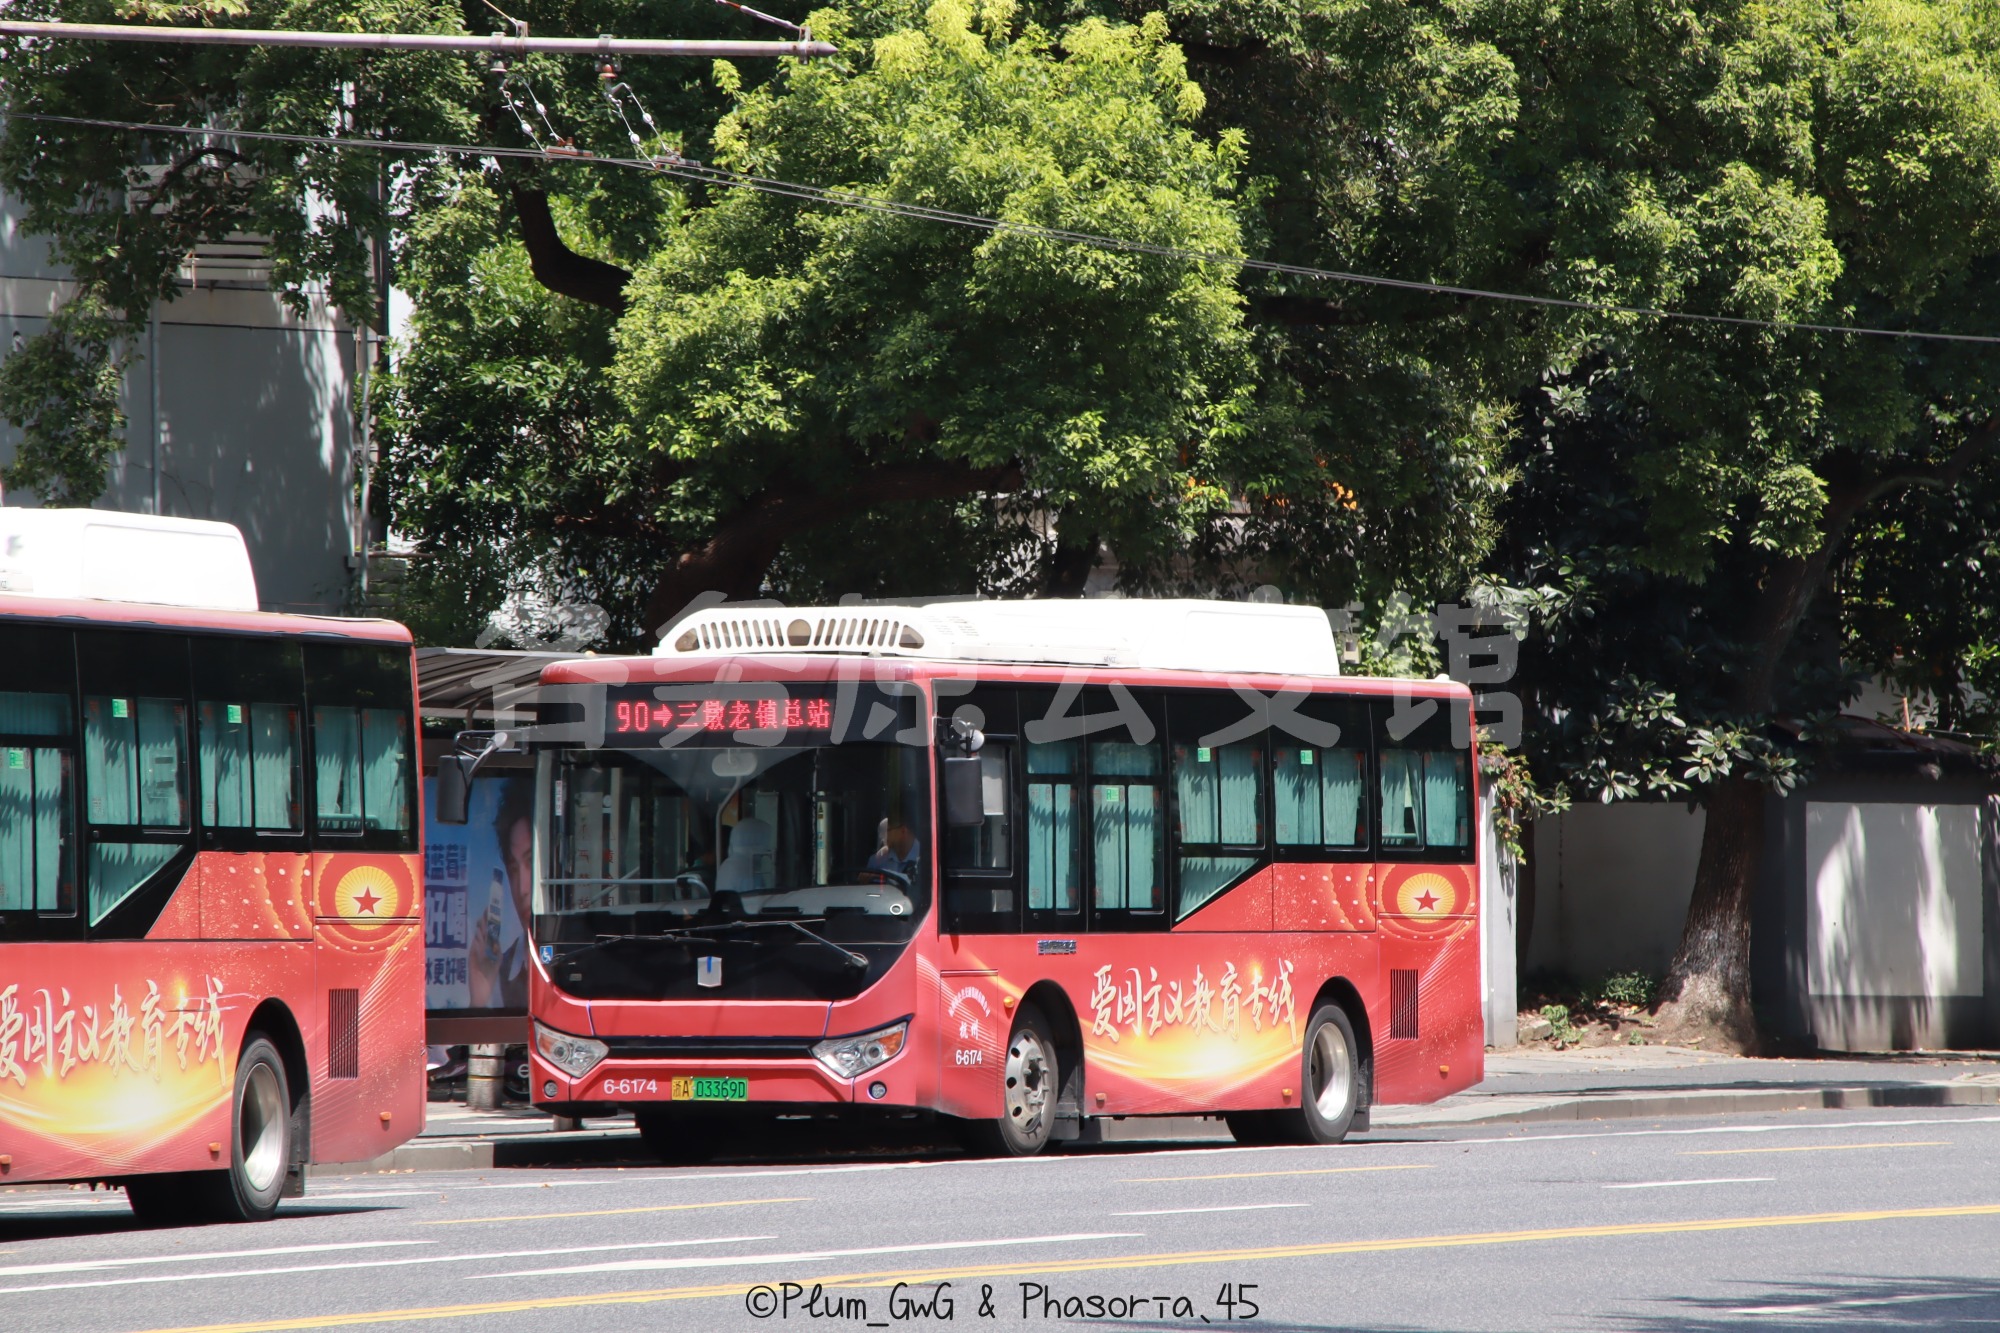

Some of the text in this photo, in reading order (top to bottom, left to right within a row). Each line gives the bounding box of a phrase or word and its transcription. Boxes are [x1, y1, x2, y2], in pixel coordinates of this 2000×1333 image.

[617, 699, 830, 732] 90 三墩老镇总站
[1090, 957, 1297, 1045] 爱国主义教育专线
[0, 974, 226, 1087] 爱国主义教育专线
[955, 1049, 983, 1066] 6-6174
[603, 1078, 658, 1095] 6-6174
